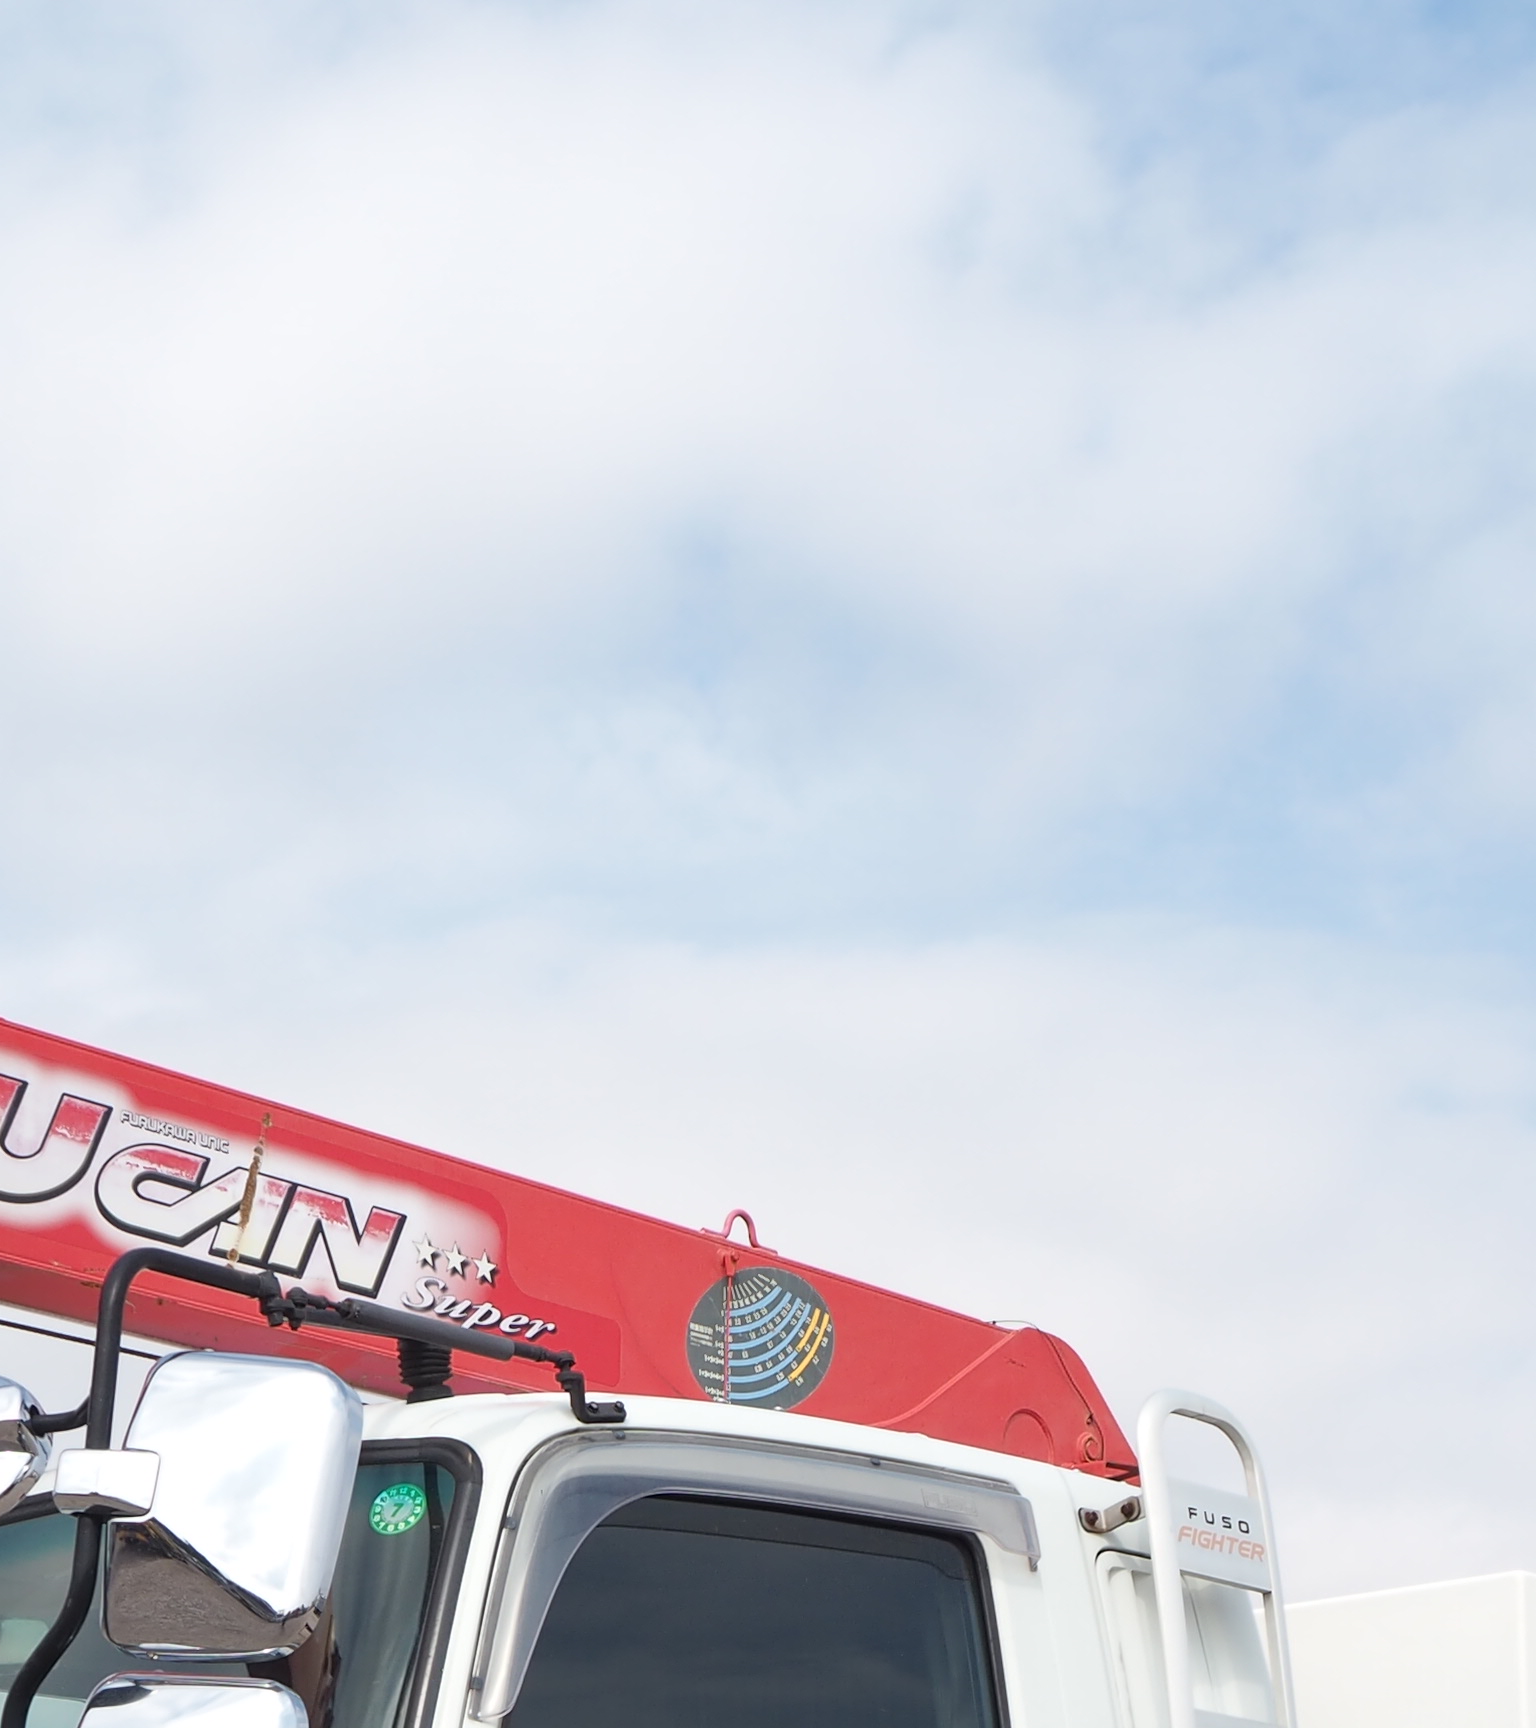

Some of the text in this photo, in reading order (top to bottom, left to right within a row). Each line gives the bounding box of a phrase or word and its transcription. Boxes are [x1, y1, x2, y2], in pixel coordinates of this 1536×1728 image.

[121, 1110, 229, 1154] FURUKAWA UNIC
[400, 1276, 557, 1339] Super
[390, 1502, 405, 1518] 7
[1187, 1506, 1250, 1534] FUSO
[1177, 1525, 1265, 1563] FIGHTER
